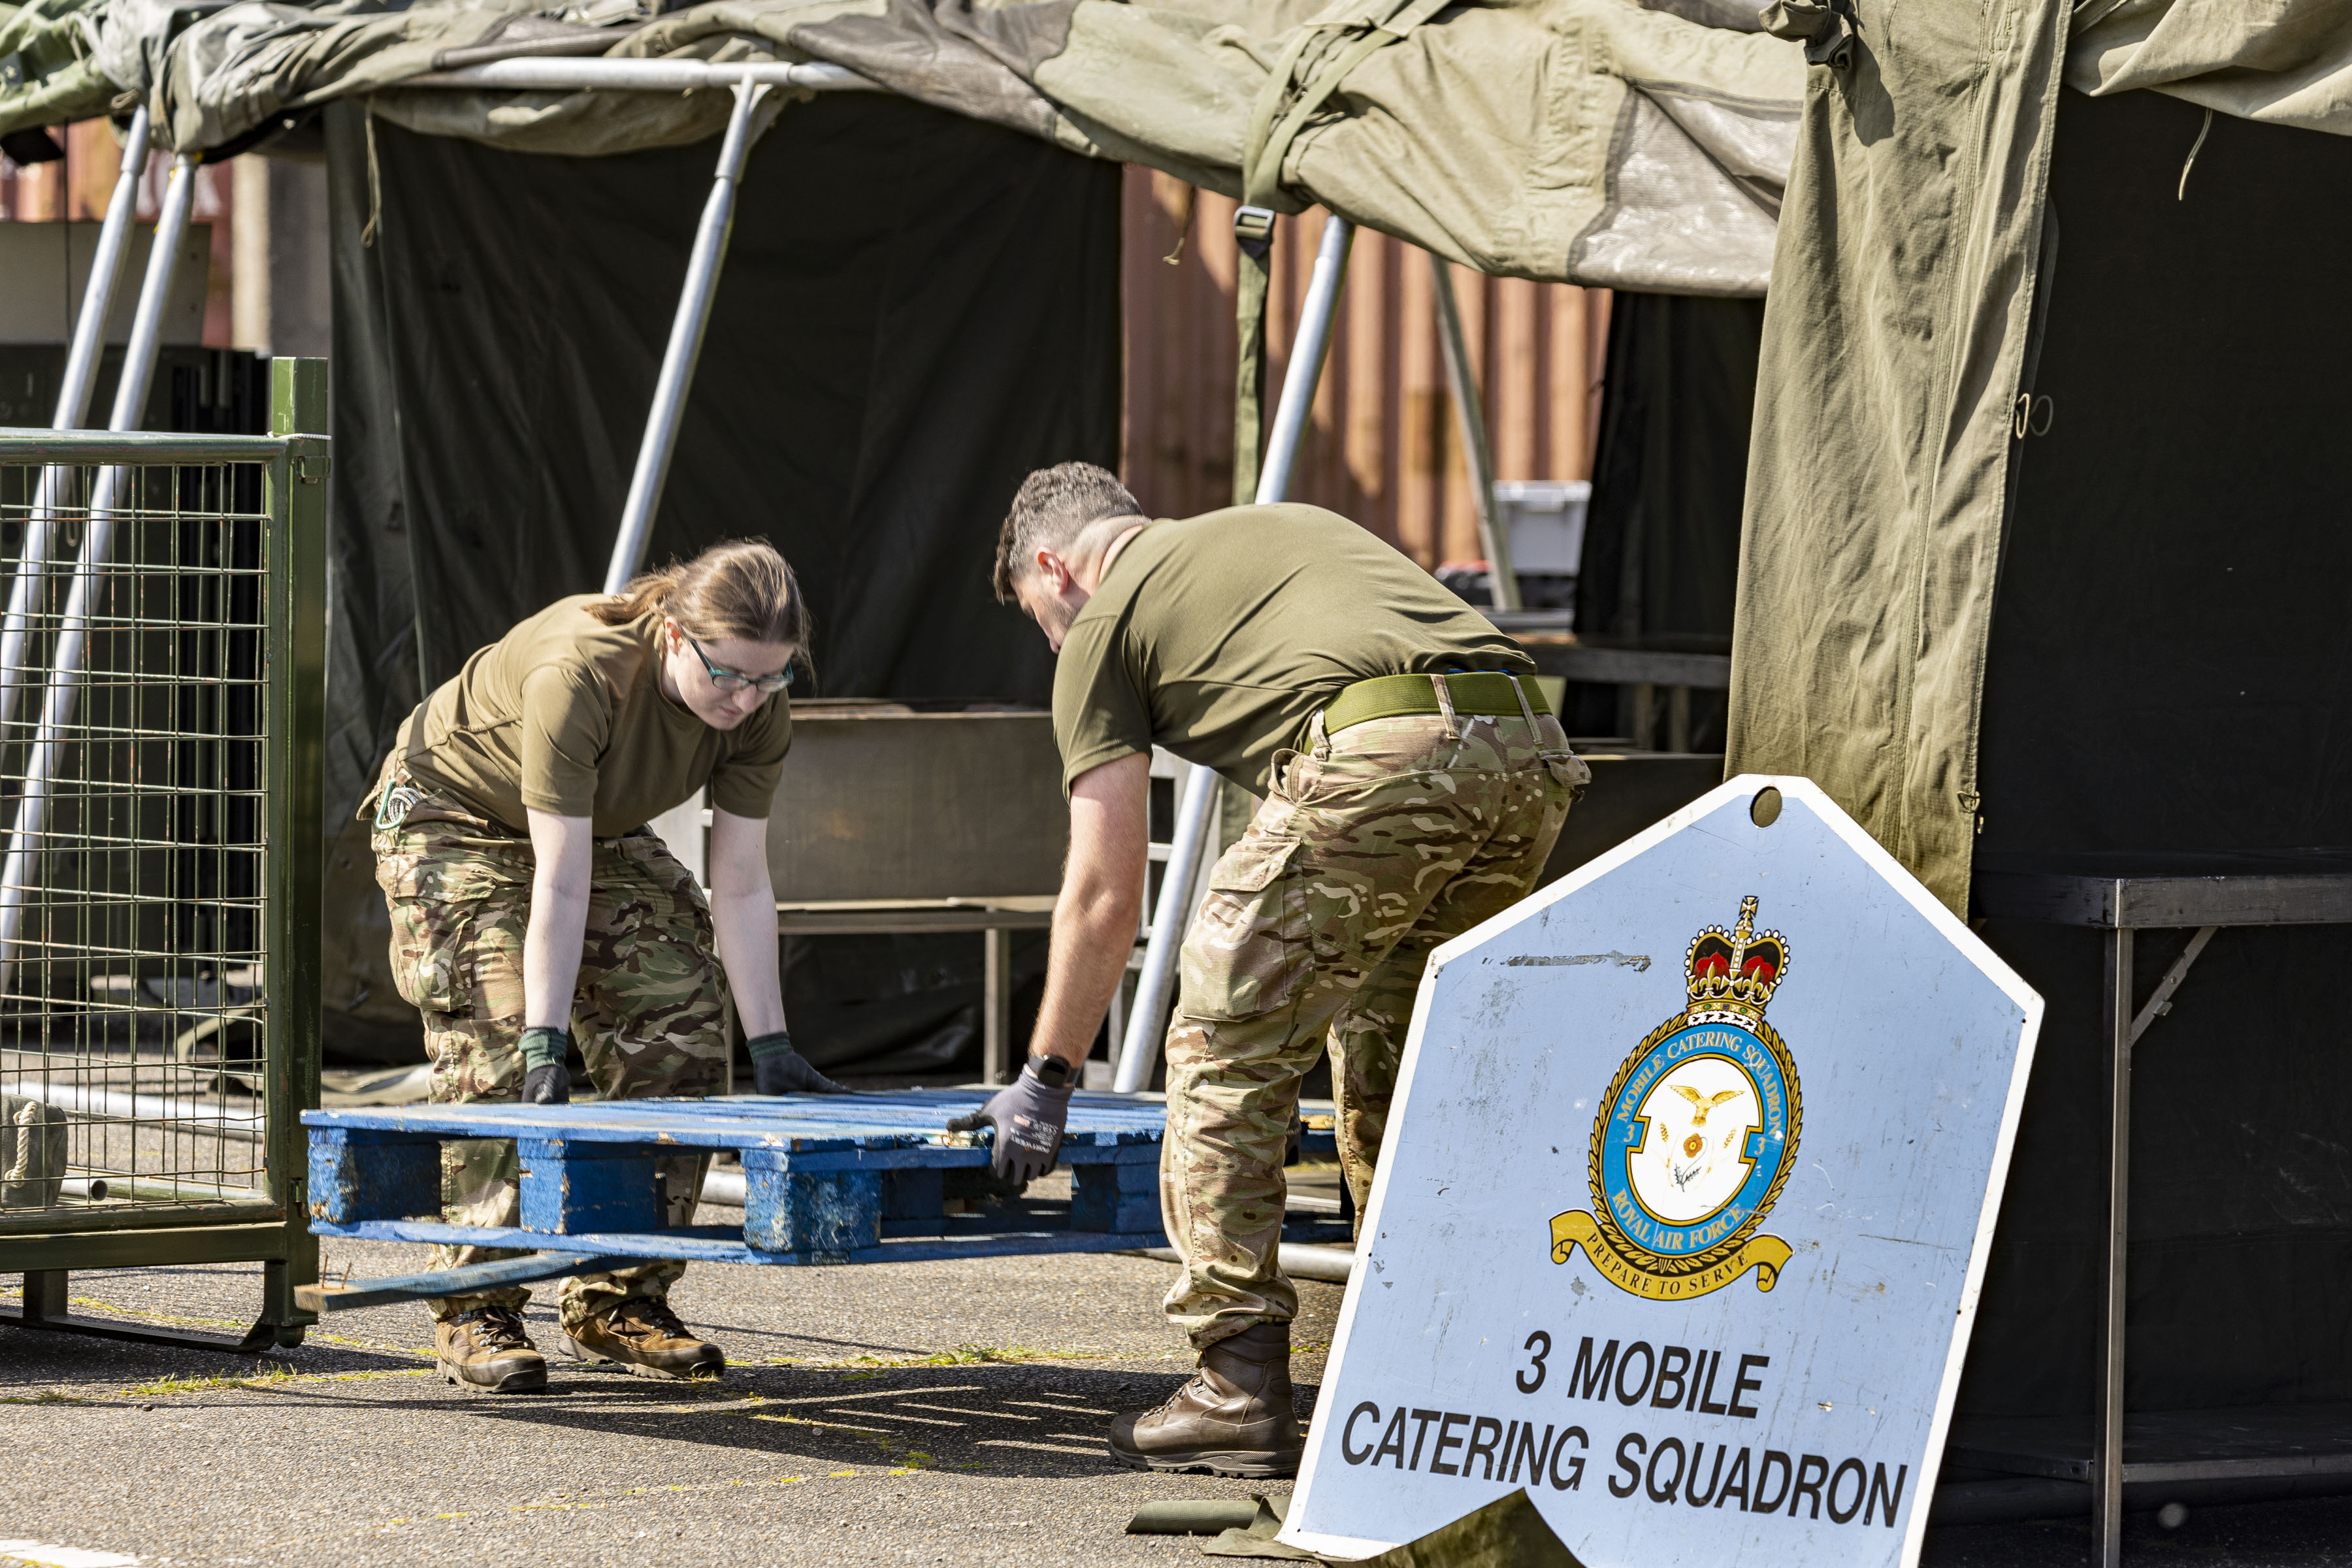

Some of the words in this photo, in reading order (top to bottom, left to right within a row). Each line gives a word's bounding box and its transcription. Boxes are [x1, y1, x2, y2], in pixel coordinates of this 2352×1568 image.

[1616, 1054, 1665, 1123] MOBILE
[1667, 1032, 1742, 1059] CATERING
[1742, 1044, 1782, 1135] SQUADRON
[1623, 1124, 1635, 1143] 3
[1754, 1137, 1766, 1156] 3
[1612, 1188, 1652, 1242] ROYAL
[1652, 1230, 1684, 1250] AIR
[1689, 1203, 1745, 1249] FORCE
[1586, 1232, 1652, 1292] PREPARE
[1659, 1281, 1681, 1296] TO
[1688, 1251, 1749, 1292] SERVE
[1516, 1330, 1552, 1395] 3
[1567, 1336, 1771, 1420] MOBILE
[1341, 1400, 1590, 1492] CATERING
[1608, 1431, 1908, 1529] SQUADRON
